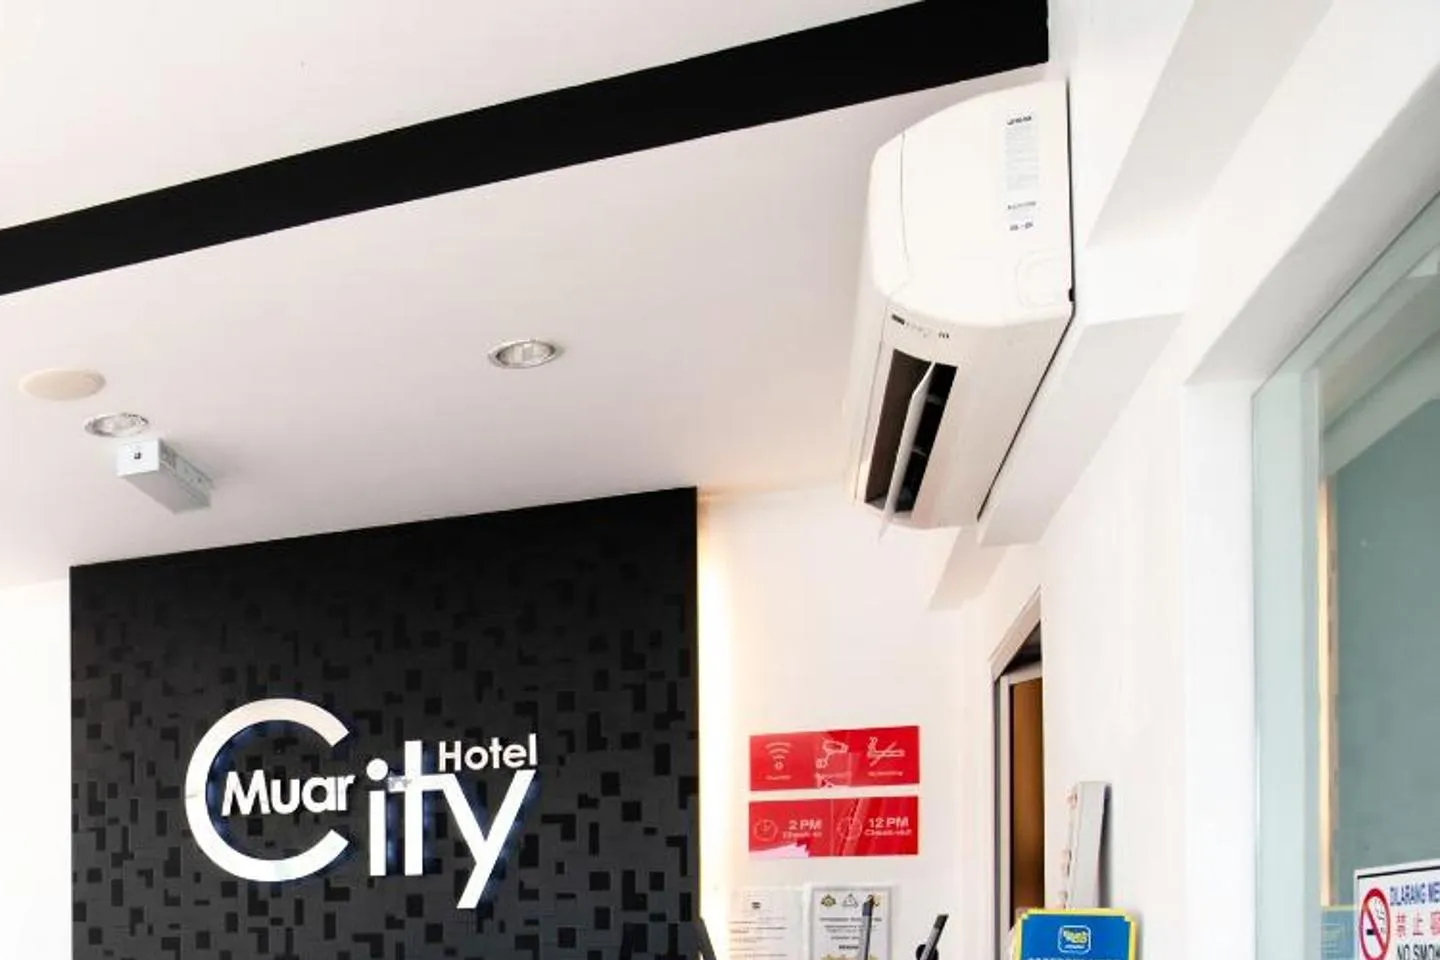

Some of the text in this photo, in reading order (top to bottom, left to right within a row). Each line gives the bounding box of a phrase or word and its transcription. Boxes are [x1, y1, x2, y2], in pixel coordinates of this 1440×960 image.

[438, 733, 537, 772] Hotel
[185, 698, 536, 909] City
[221, 769, 356, 816] Muar
[788, 819, 823, 830] 2 PM
[868, 816, 910, 828] 12 PM
